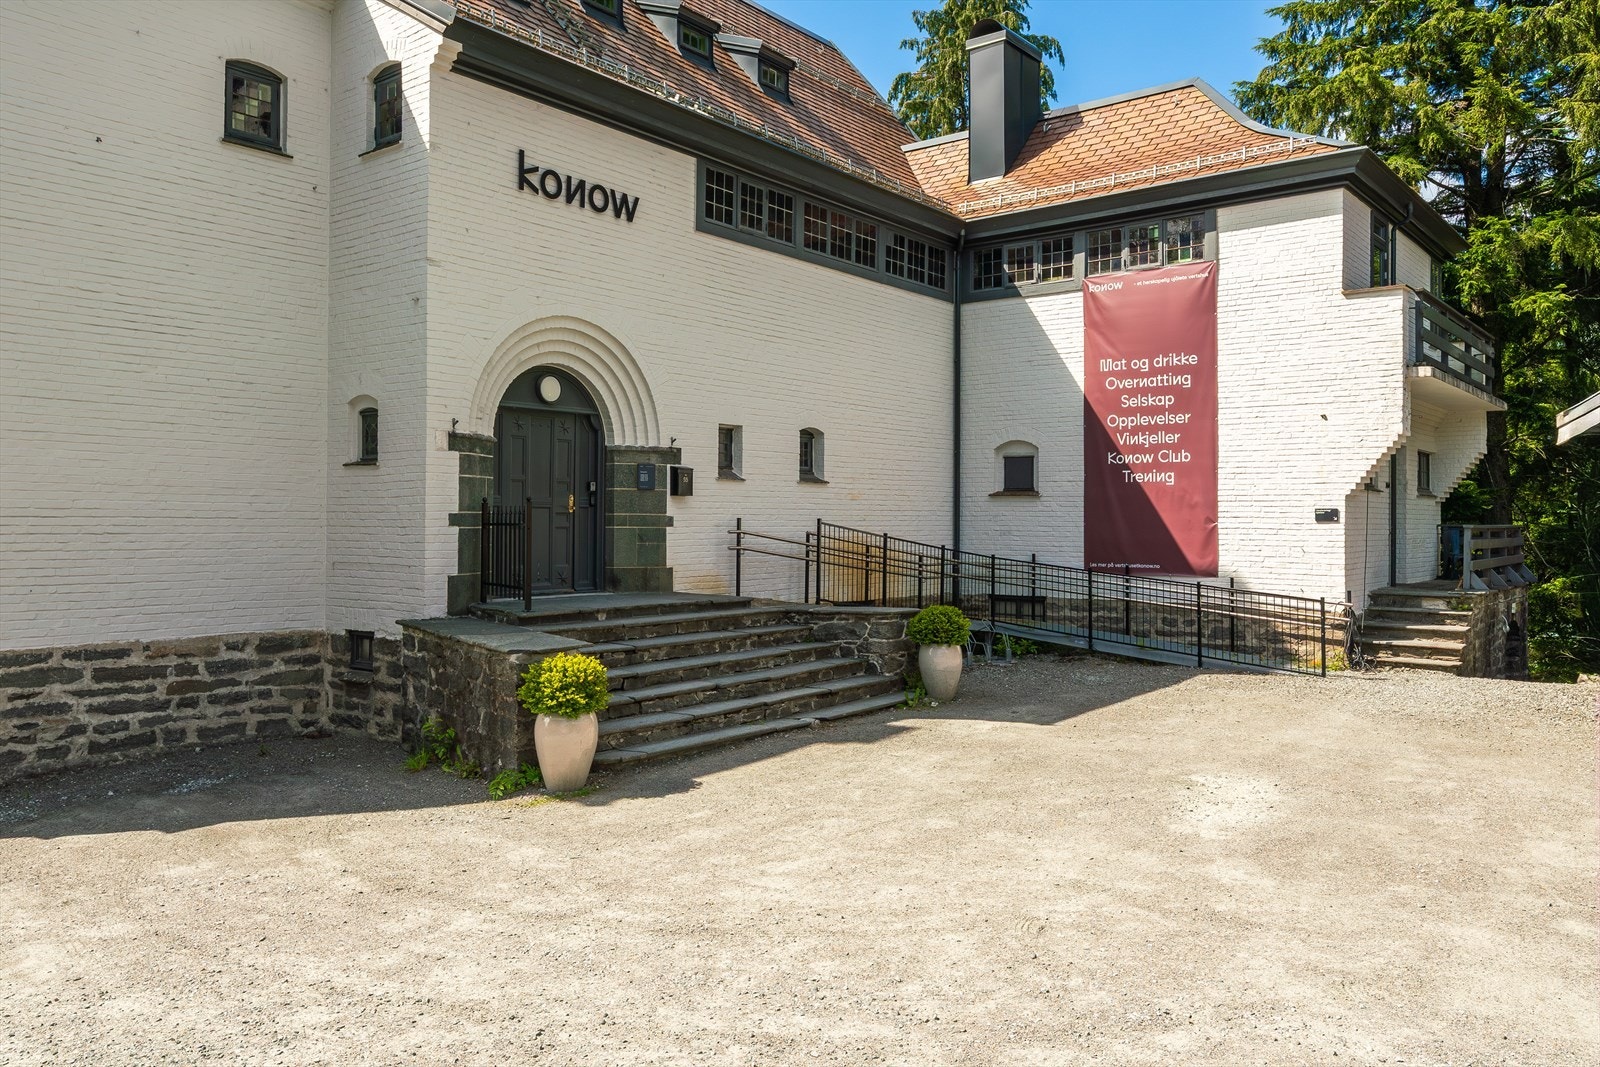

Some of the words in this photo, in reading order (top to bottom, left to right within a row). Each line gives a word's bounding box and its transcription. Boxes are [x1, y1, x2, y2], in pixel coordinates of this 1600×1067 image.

[1100, 358, 1127, 372] Mat
[1131, 358, 1149, 372] og
[1153, 352, 1198, 368] drikke
[1105, 373, 1191, 390] Overnatting
[1121, 393, 1175, 408] Selskap
[1107, 411, 1191, 430] Opplevelser
[1116, 430, 1181, 448] Vinkjeller
[1107, 451, 1154, 465] Konow
[1158, 449, 1191, 463] Club
[1122, 469, 1175, 486] Trening
